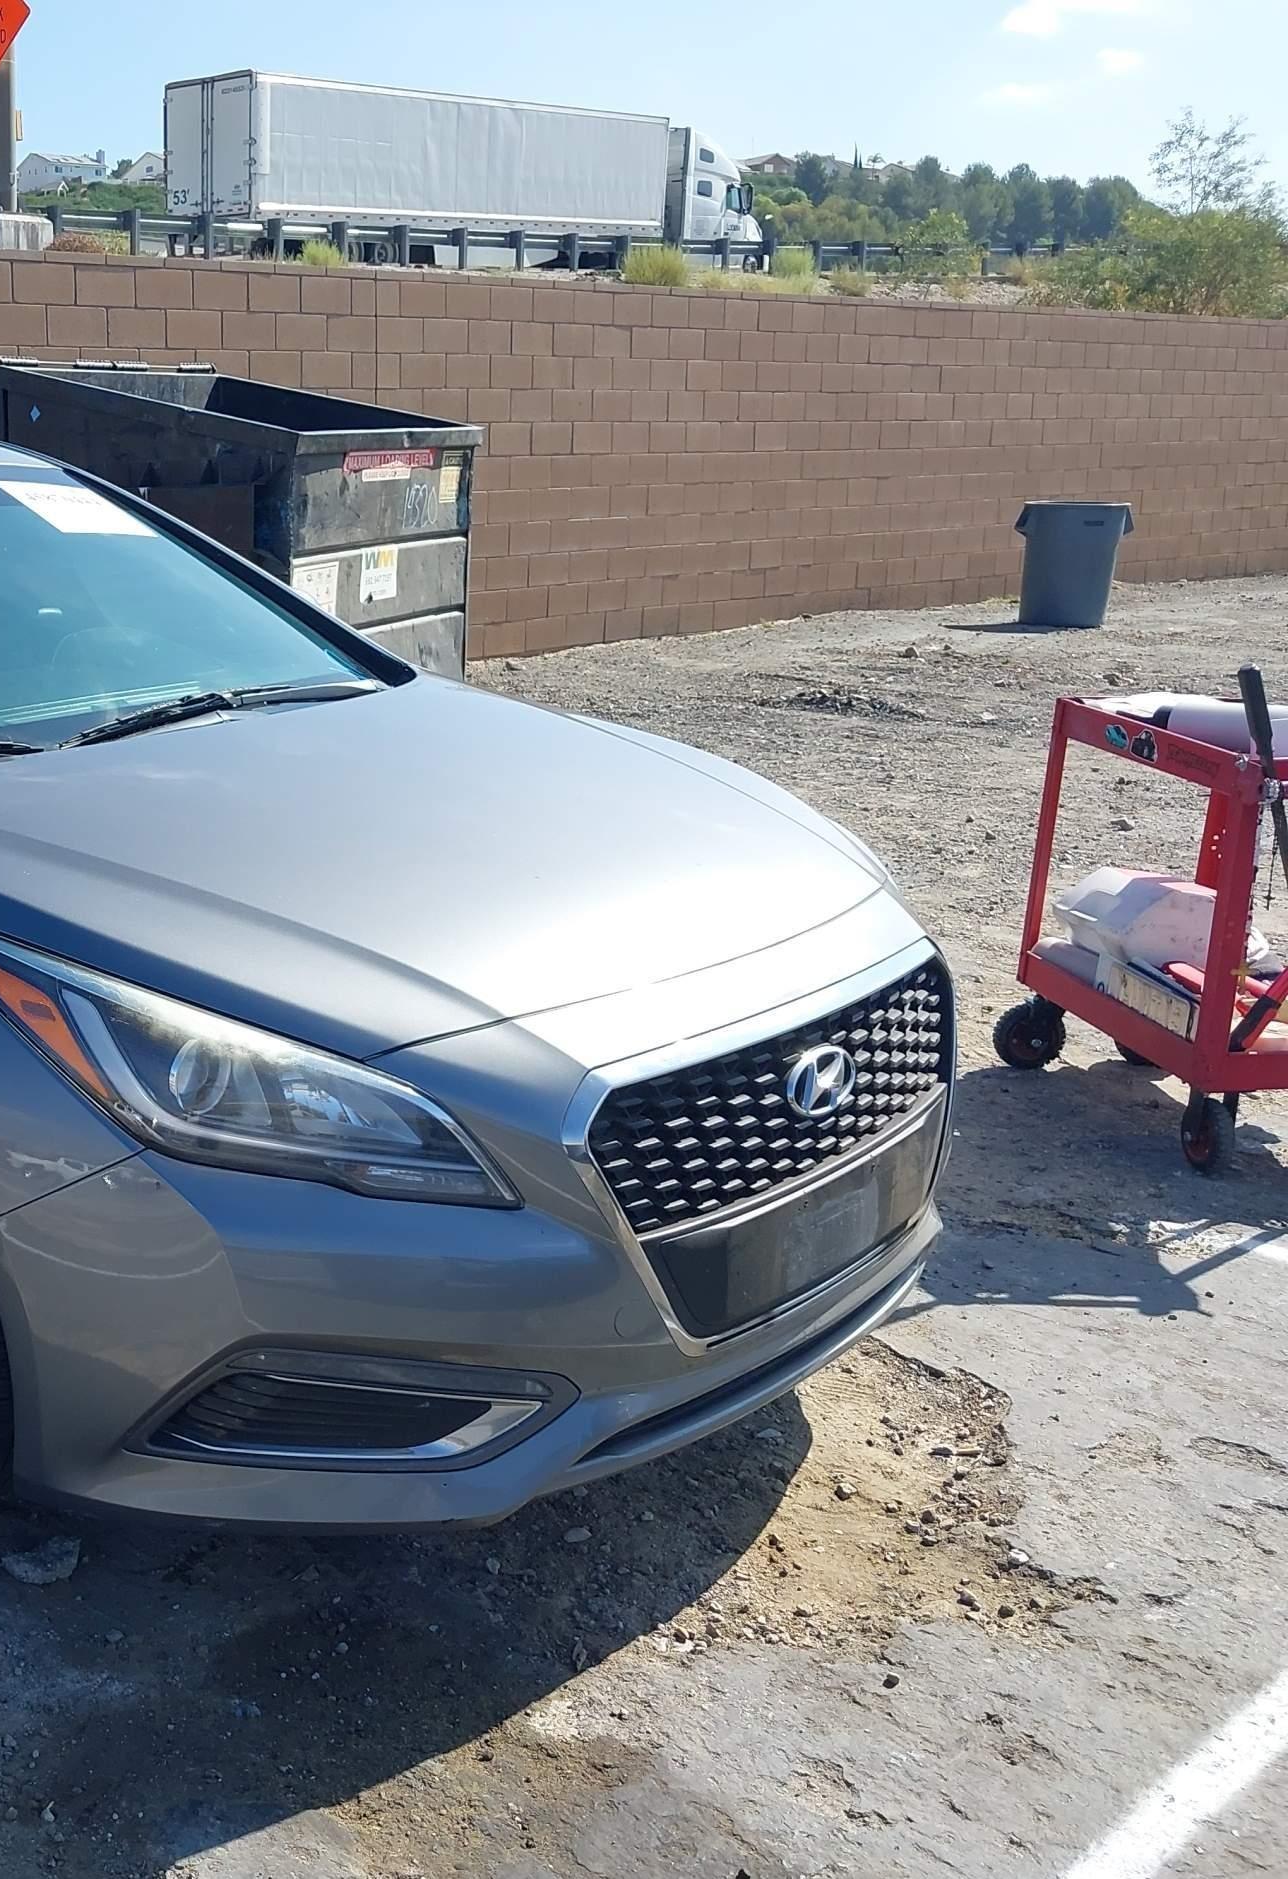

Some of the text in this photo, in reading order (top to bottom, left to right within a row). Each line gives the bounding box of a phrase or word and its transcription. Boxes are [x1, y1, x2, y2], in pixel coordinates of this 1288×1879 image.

[348, 454, 380, 469] MAXIMUM
[411, 453, 432, 467] LEVEL
[364, 550, 394, 569] WM
